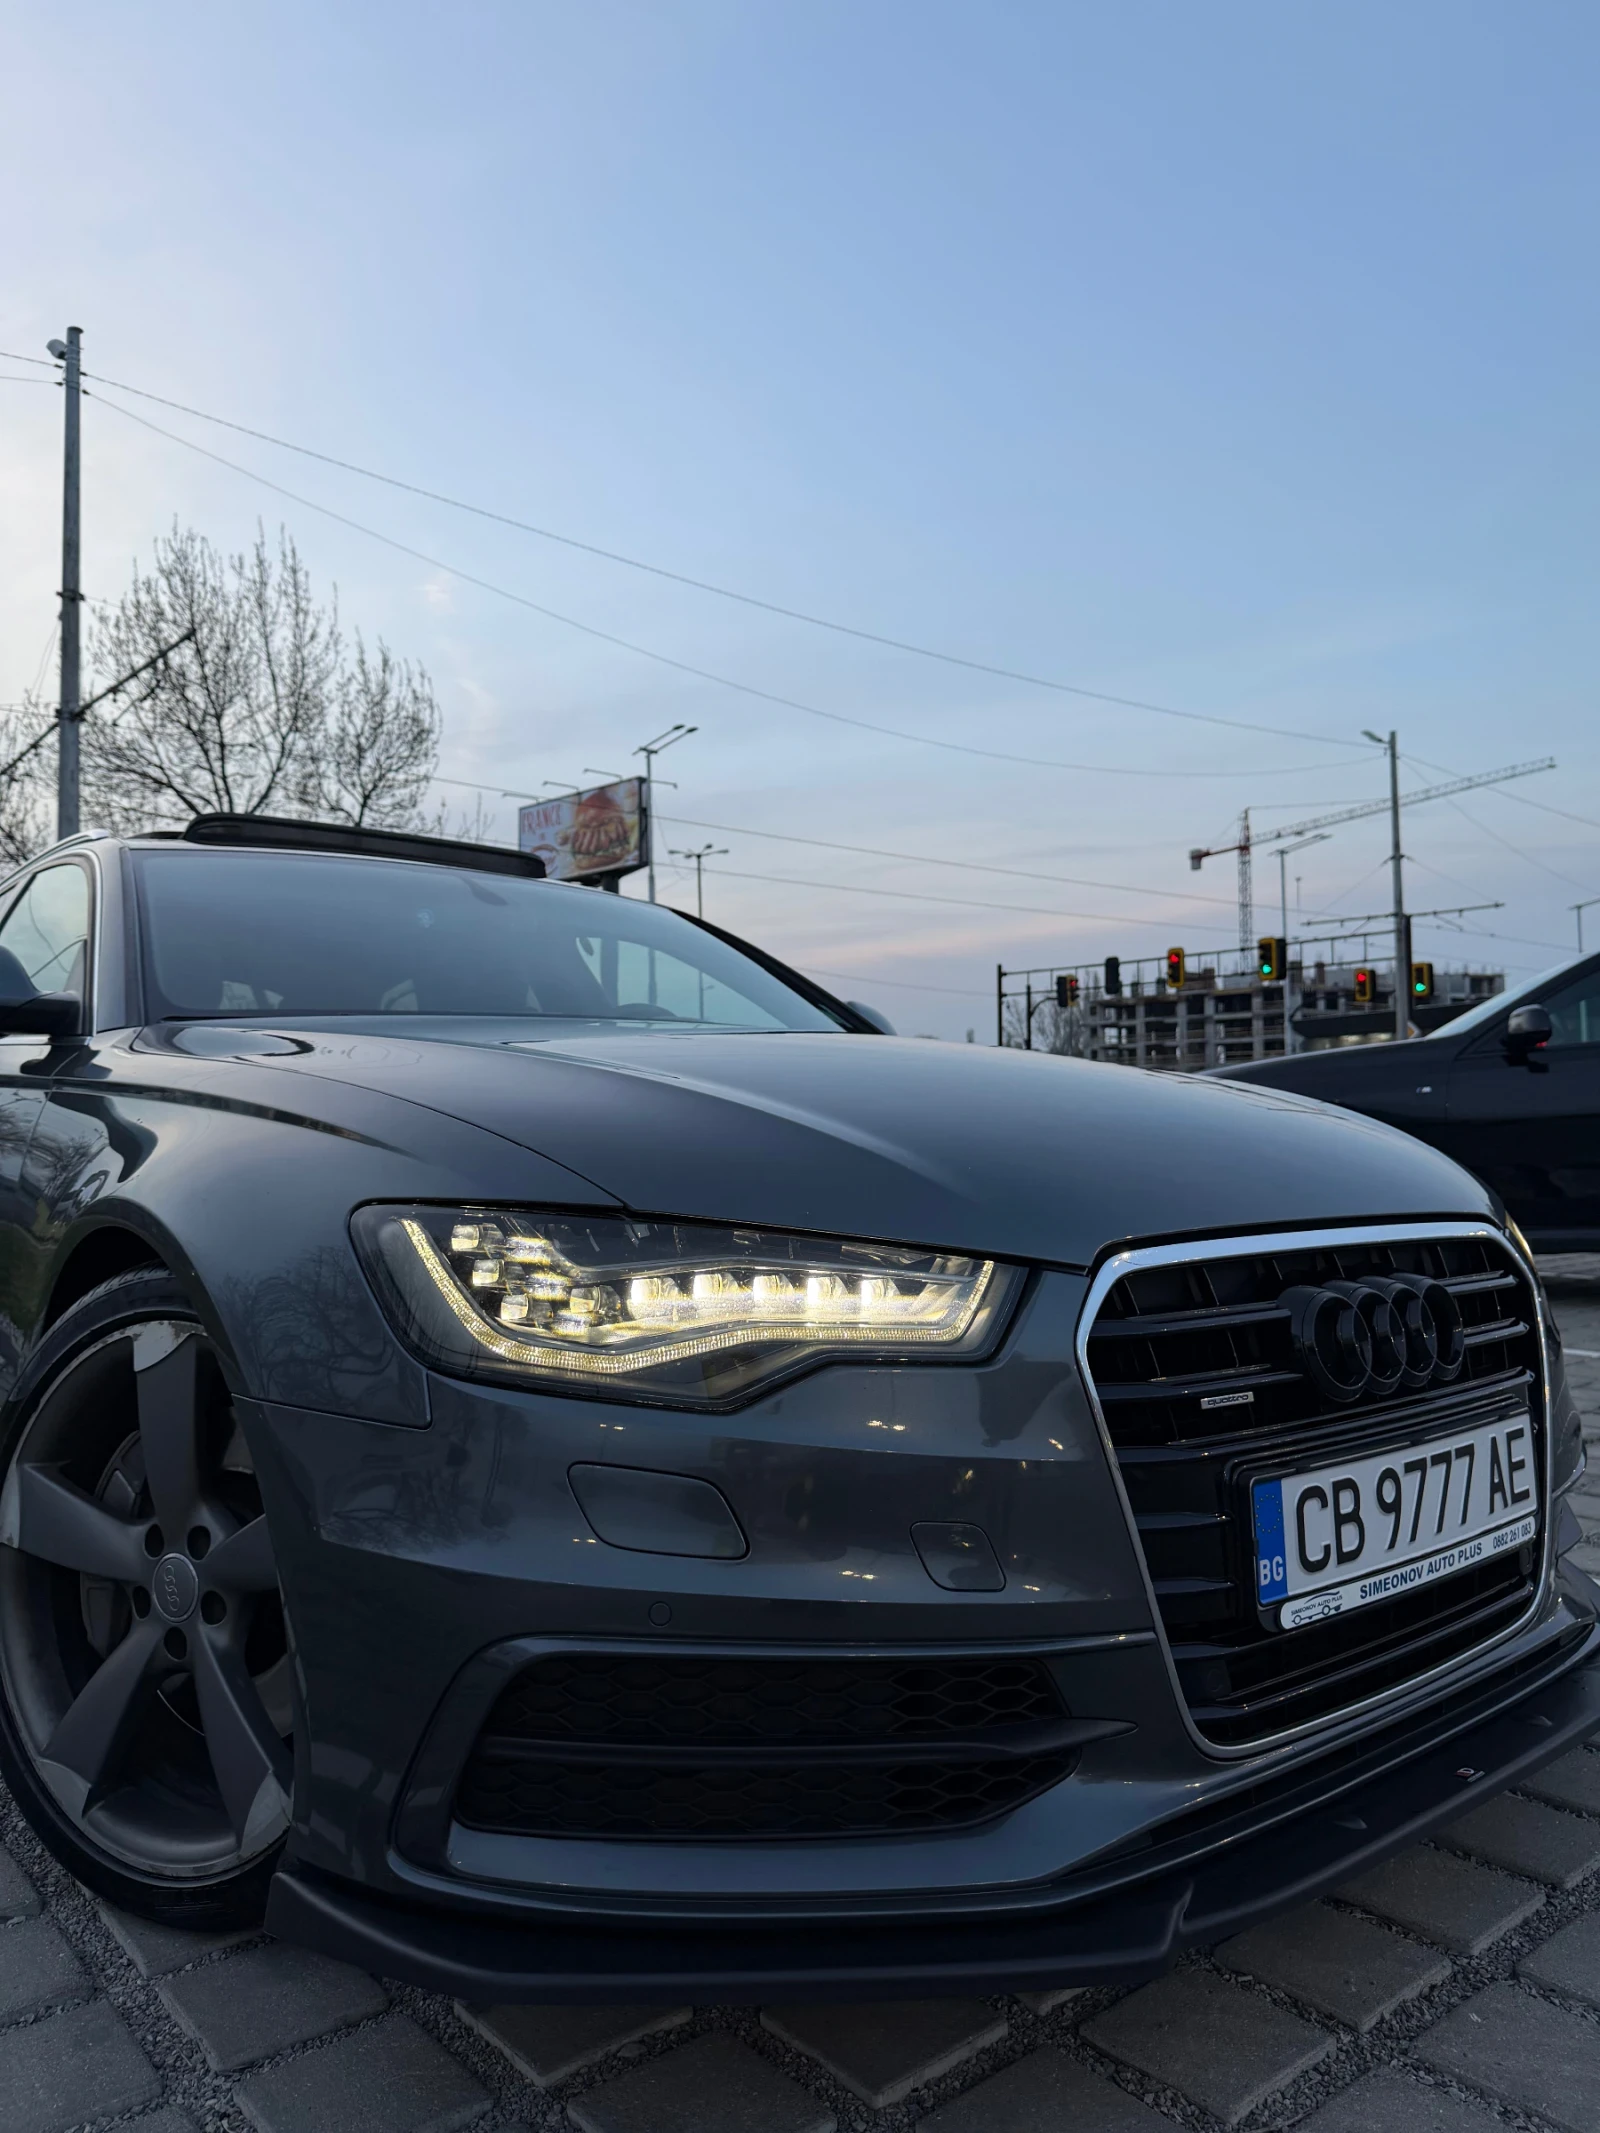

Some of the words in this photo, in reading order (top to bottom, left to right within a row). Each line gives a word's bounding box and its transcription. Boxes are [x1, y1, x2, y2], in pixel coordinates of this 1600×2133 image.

[1208, 1394, 1249, 1406] quattro
[1296, 1477, 1365, 1573] CB
[1376, 1443, 1475, 1551] 9777
[1489, 1427, 1531, 1515] AE
[1259, 1556, 1284, 1586] BG
[1360, 1563, 1424, 1599] SIMEONOV
[1427, 1556, 1455, 1575] AUTO
[1457, 1542, 1482, 1563] PLUS
[1290, 1604, 1317, 1615] SIMEONOV
[1317, 1598, 1331, 1608] AUTO
[1332, 1594, 1343, 1603] PLUS
